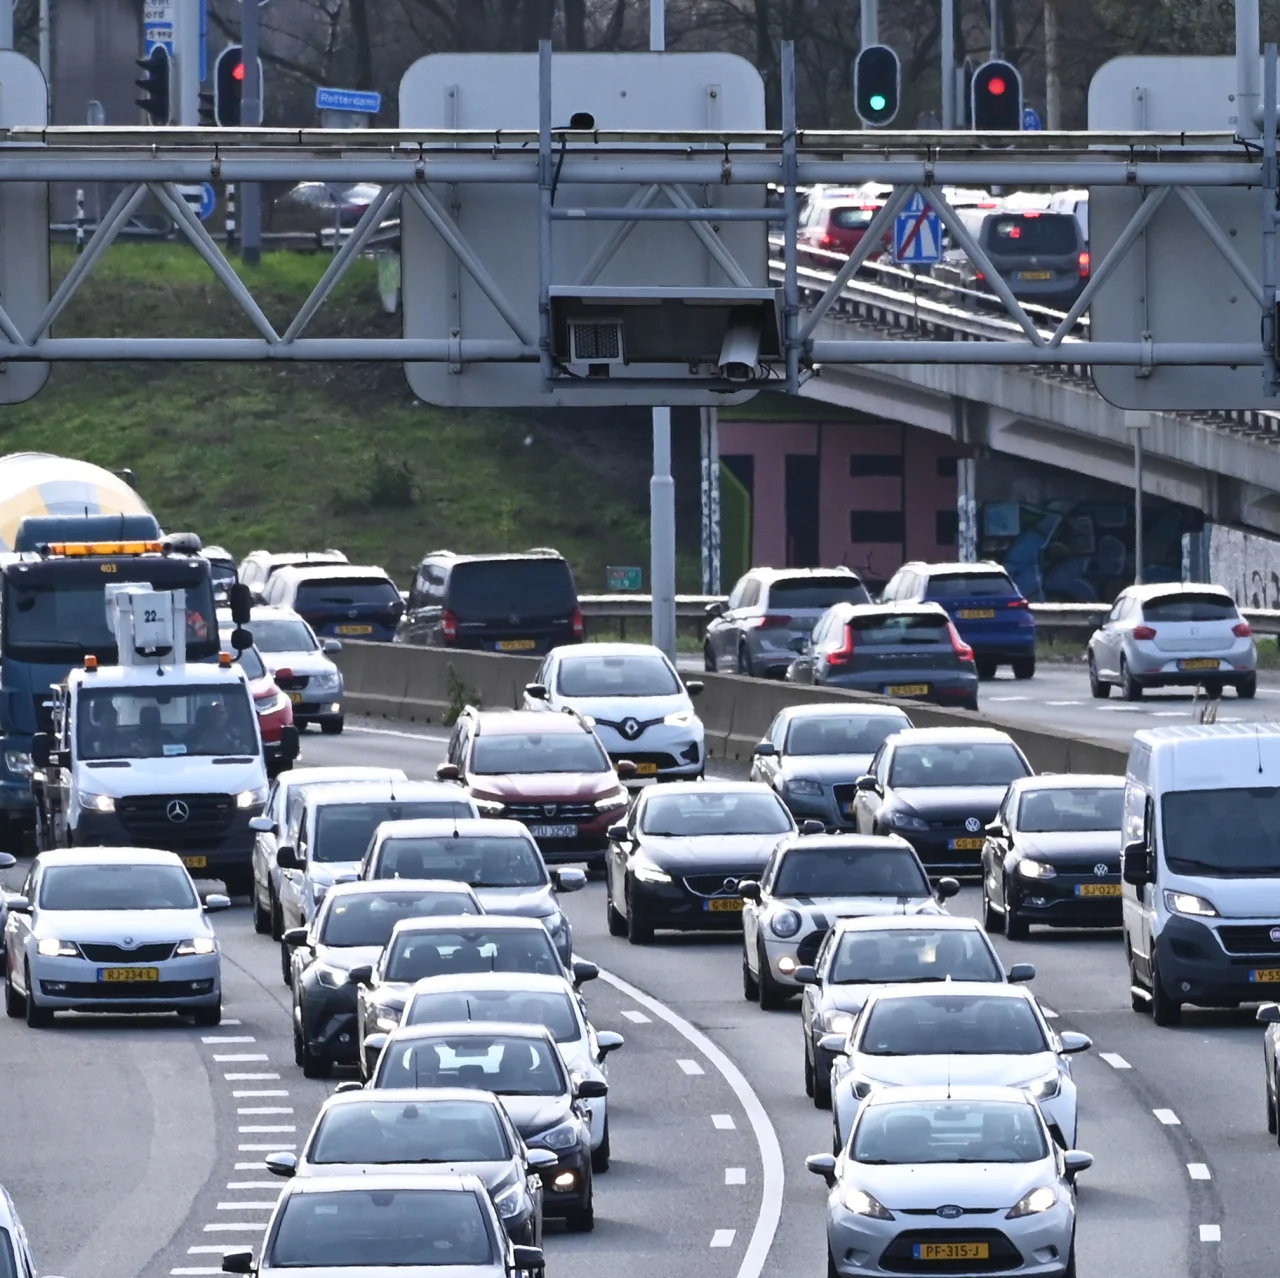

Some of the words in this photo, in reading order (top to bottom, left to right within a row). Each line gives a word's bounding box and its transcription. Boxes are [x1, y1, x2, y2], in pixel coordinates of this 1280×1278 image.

[320, 93, 377, 108] Rotterdam
[144, 610, 157, 623] 22
[1083, 885, 1121, 895] SJ-027-
[712, 900, 743, 910] G-810-
[107, 969, 154, 980] RJ-234-L
[926, 1245, 980, 1257] PF-315-J
